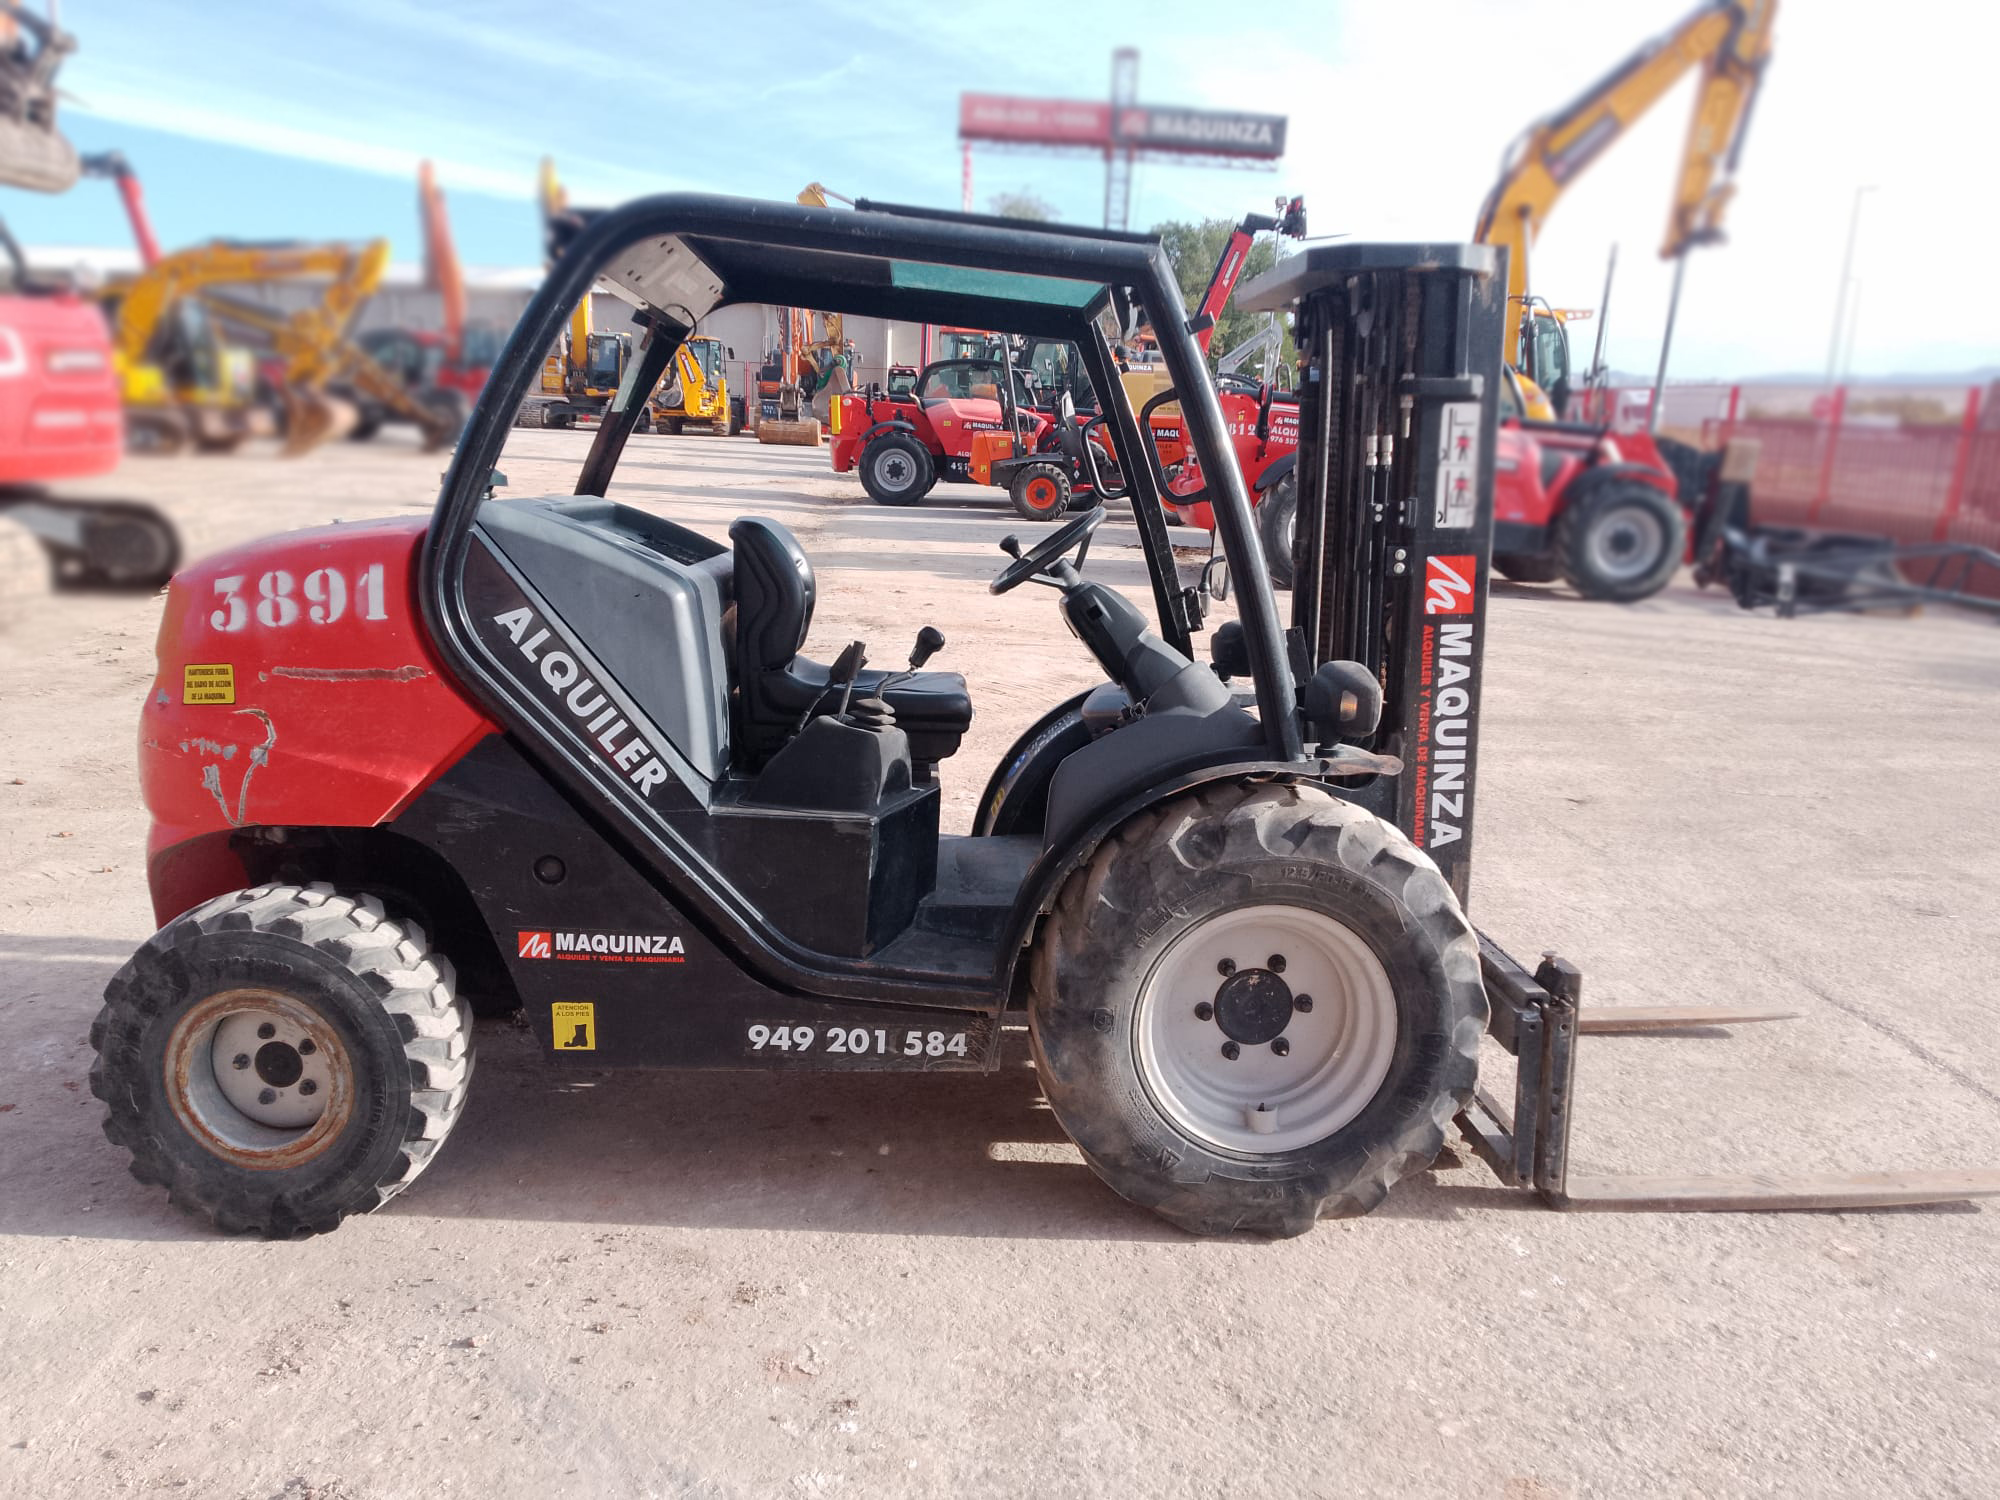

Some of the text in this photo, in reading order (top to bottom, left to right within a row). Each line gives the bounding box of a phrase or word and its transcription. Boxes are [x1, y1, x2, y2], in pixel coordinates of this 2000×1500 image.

[1152, 117, 1273, 145] MAQUINZA
[210, 563, 388, 632] 3891
[1420, 624, 1434, 686] ALQUILER
[493, 607, 668, 797] ALQUILER
[1430, 623, 1473, 849] MAQUINZA
[555, 932, 685, 954] MAQUINZA
[556, 953, 591, 961] ALQUILER
[747, 1024, 968, 1057] 949 201 584
